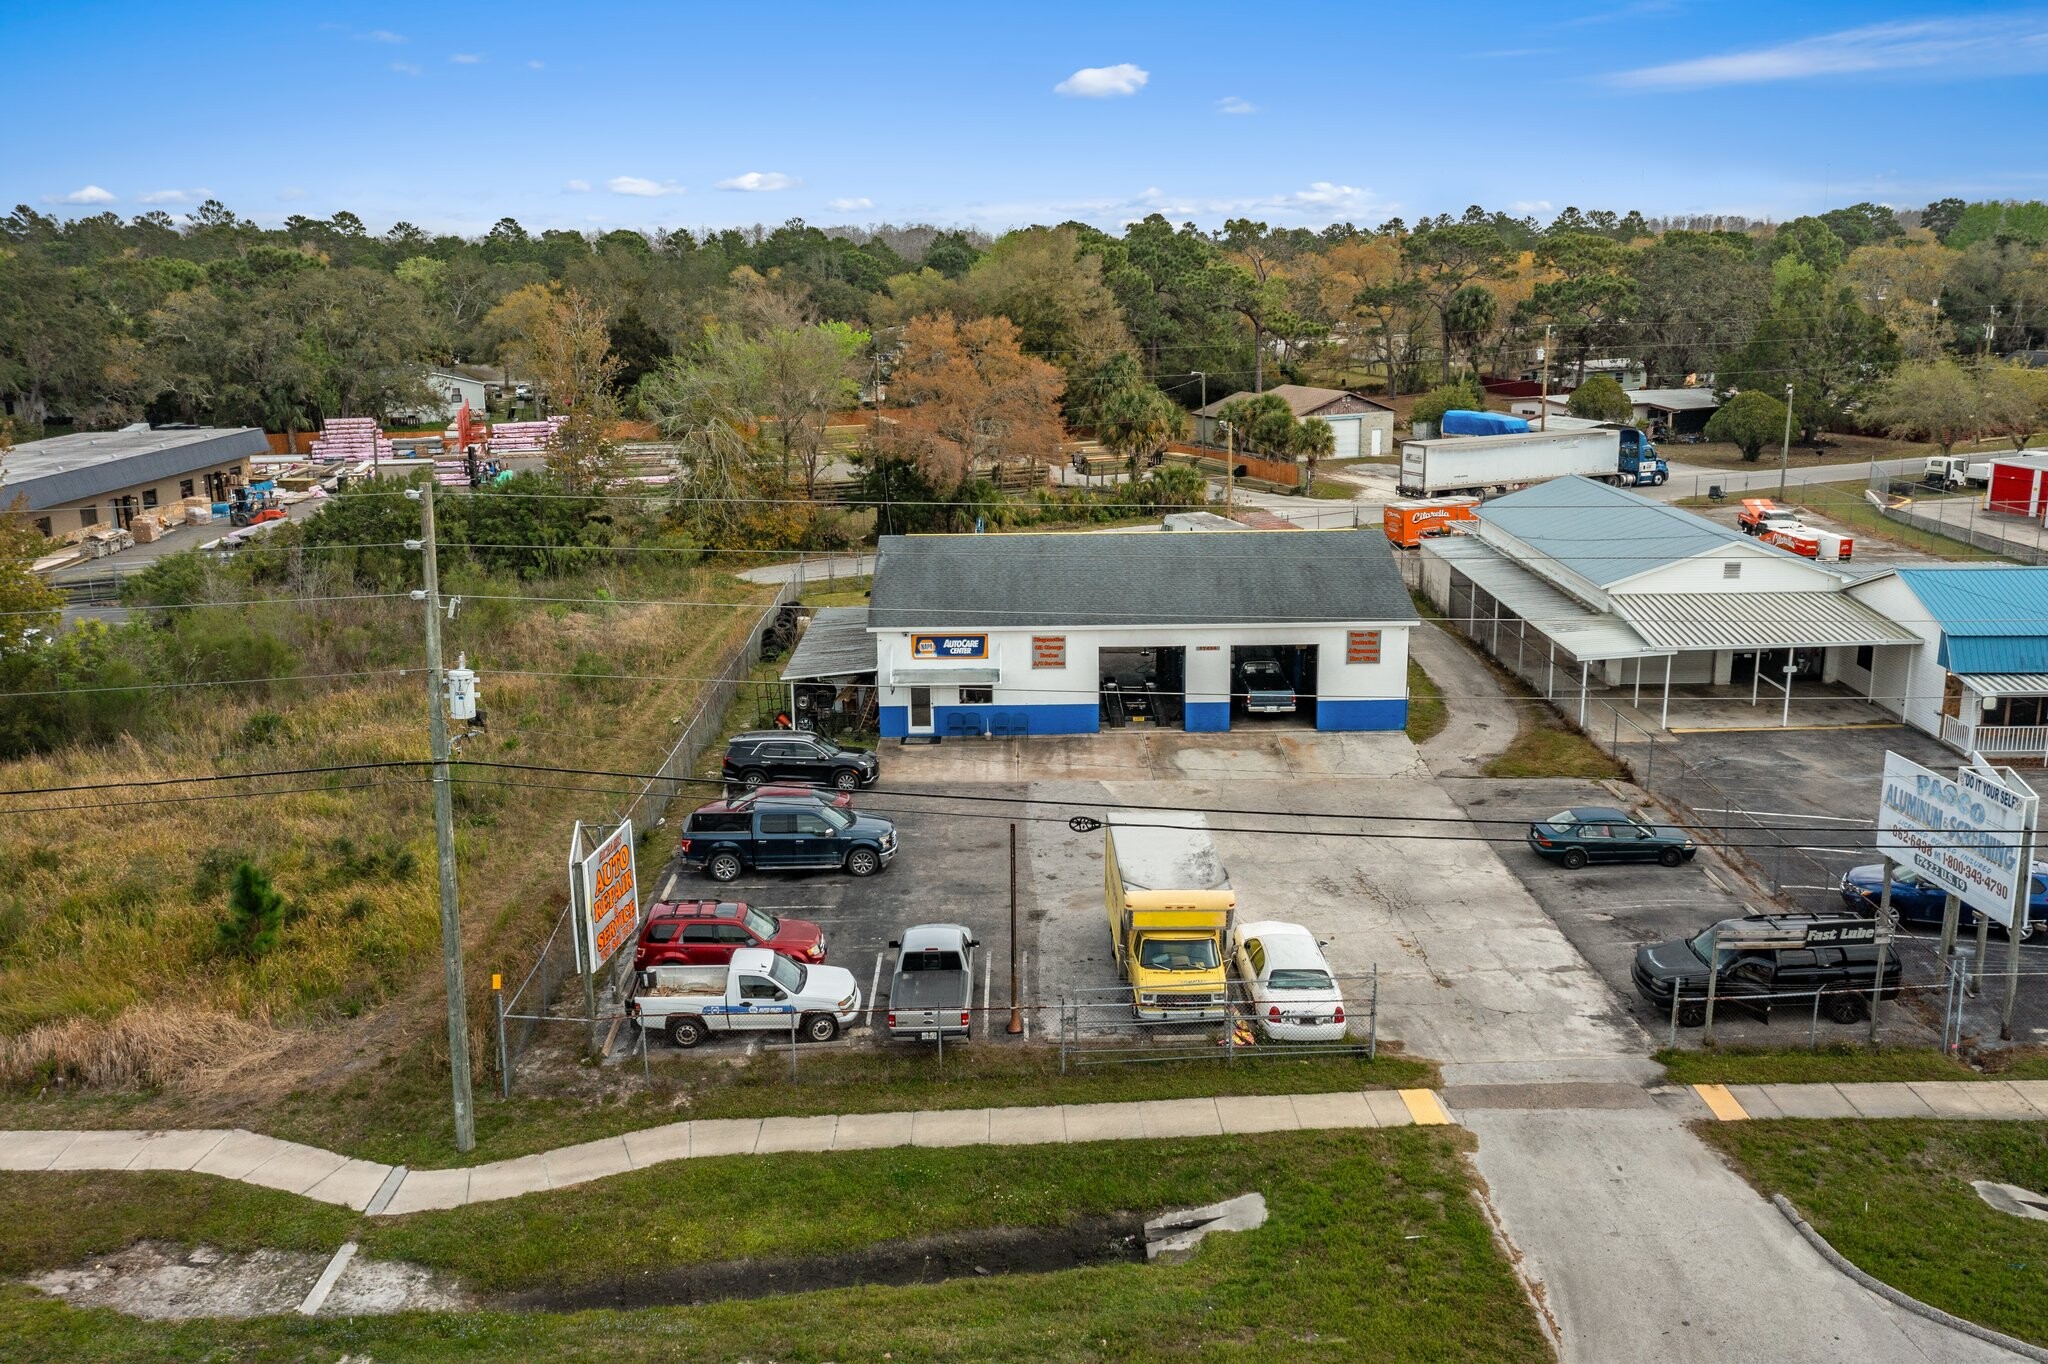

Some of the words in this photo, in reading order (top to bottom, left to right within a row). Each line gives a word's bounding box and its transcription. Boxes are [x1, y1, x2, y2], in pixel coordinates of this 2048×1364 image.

[1412, 510, 1450, 524] Citarella
[1917, 774, 1985, 824] PASCO
[1975, 779, 1981, 792] IT
[1983, 782, 1999, 801] YOUR
[1885, 784, 1943, 830] ALUMINUM
[1949, 816, 2016, 871] SCREENING
[594, 869, 633, 923] REPAIR
[595, 844, 630, 898] AUTO
[1956, 876, 1966, 889] 19
[597, 898, 635, 952] SERVICE
[1807, 929, 1837, 941] Fast
[1840, 928, 1875, 939] Lube
